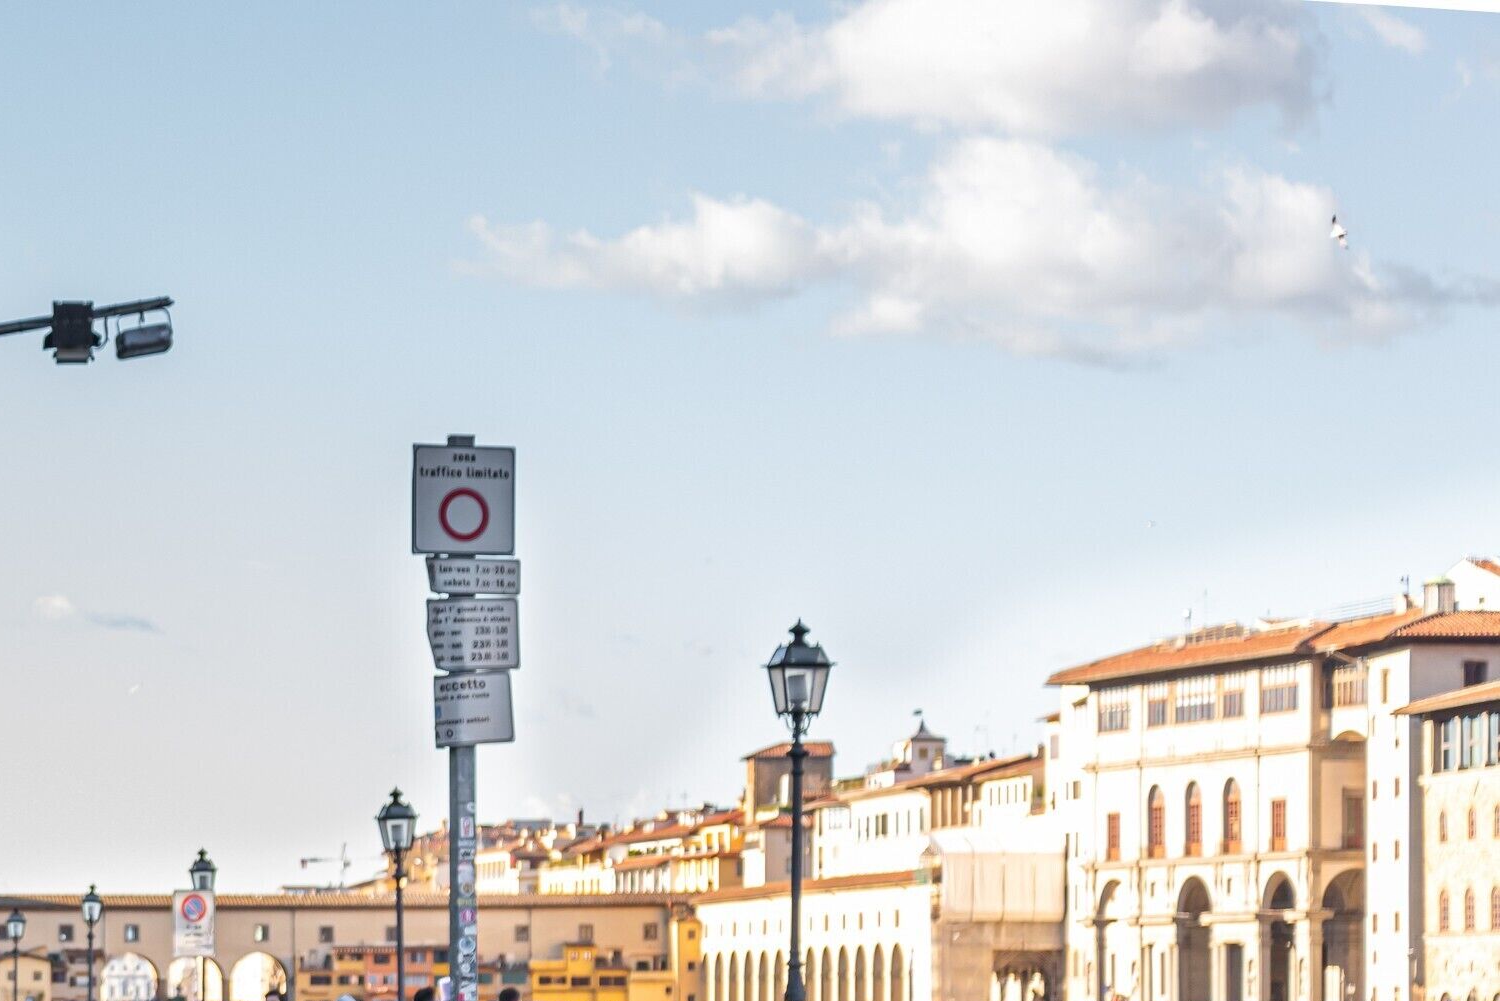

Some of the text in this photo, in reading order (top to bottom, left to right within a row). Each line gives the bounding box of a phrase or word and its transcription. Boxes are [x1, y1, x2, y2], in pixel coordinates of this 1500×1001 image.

[453, 453, 476, 463] zona
[420, 465, 510, 480] traffico limitato
[440, 678, 486, 692] eccetto
